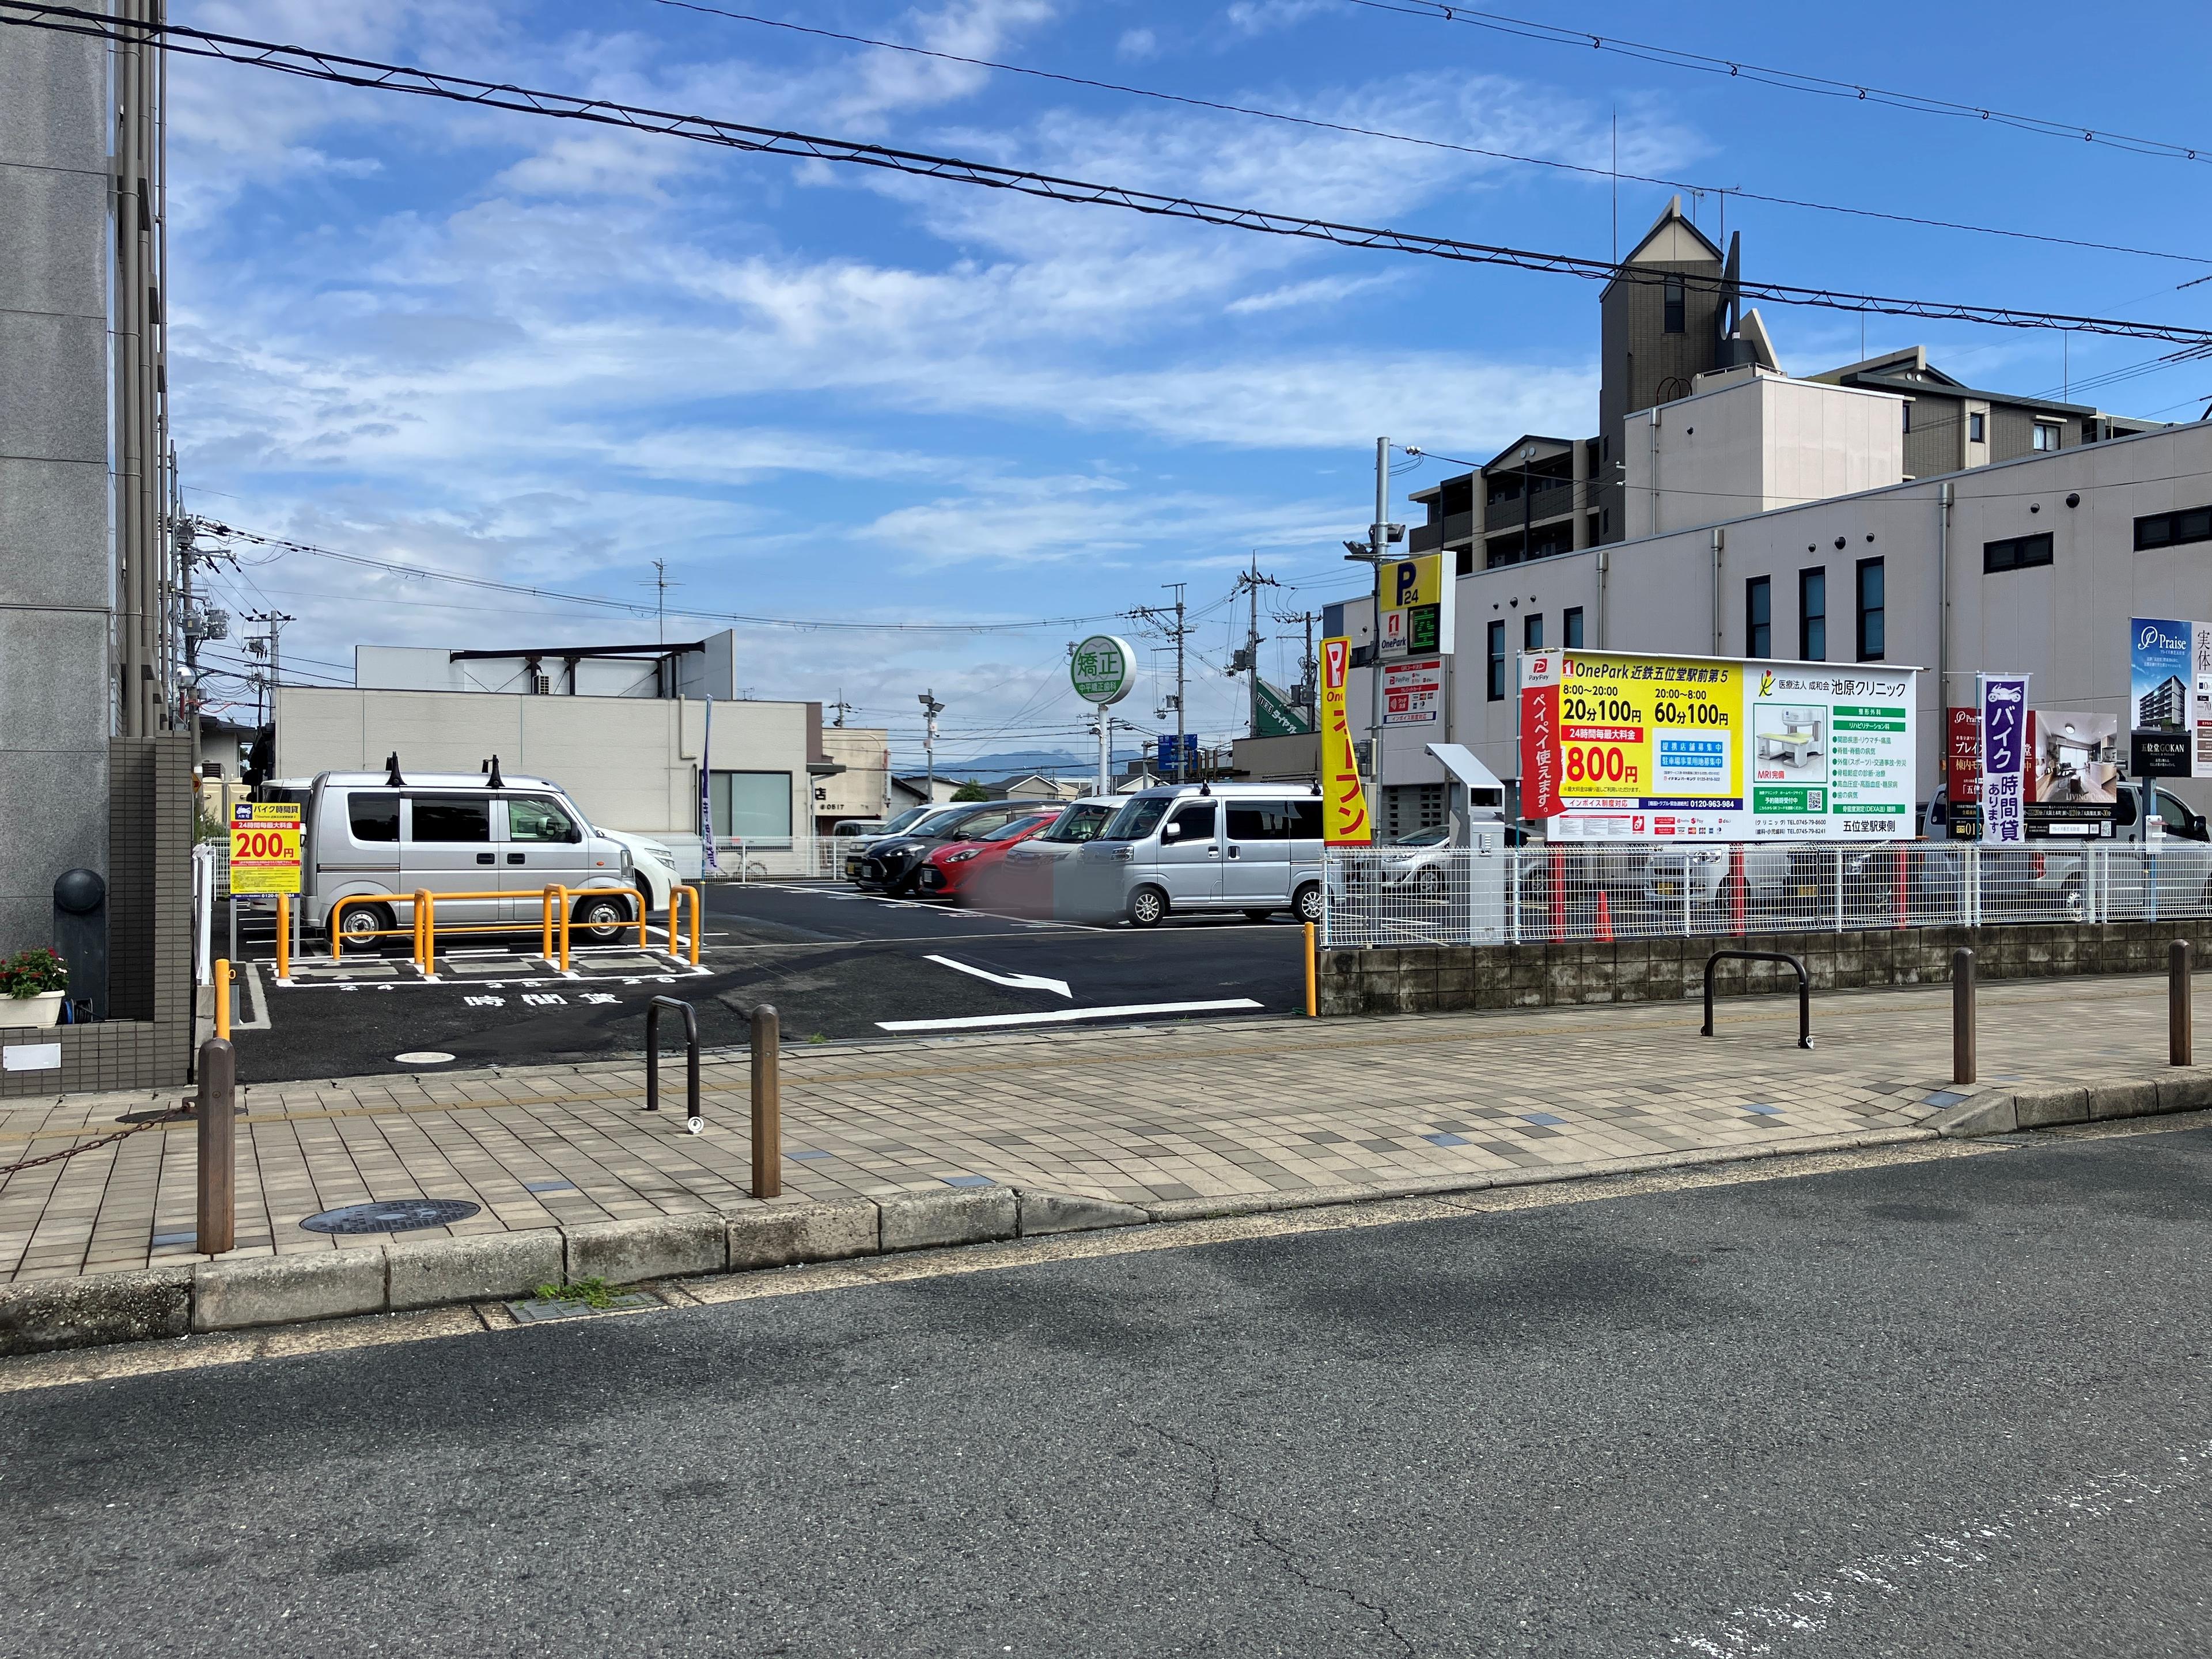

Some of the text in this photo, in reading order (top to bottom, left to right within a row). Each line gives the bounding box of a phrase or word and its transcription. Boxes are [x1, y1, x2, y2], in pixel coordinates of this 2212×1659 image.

[1396, 562, 1416, 606] P
[1404, 589, 1419, 604] 24
[1381, 637, 1407, 649] OnePark
[2159, 634, 2186, 649] Praise
[1077, 652, 1118, 677] 矯正
[1575, 662, 1729, 683] OnePark 近鉄五位堂駅前第5
[1079, 681, 1116, 692] 中平矯正歯科
[1779, 679, 1906, 697] 医療法人 成和会 池原クリニック
[1256, 694, 1272, 712] TIRE
[1563, 698, 1729, 726] 20分100円 60分100円
[1569, 728, 1636, 740] 24時間毎最大料金
[1991, 705, 2015, 768] バイク
[1533, 694, 1551, 812] ペイペイ使えます。
[1662, 742, 1721, 752] 提携店舗募集中
[1566, 747, 1637, 783] 800円
[1758, 770, 1785, 779] MRI完備
[1569, 799, 1628, 807] インボイス制度対応
[2066, 793, 2089, 801] LIVING
[1988, 783, 2000, 834] あります
[1999, 774, 2019, 842] 時間貸
[1843, 820, 1895, 832] 五位堂駅東側
[235, 833, 294, 858] 200円
